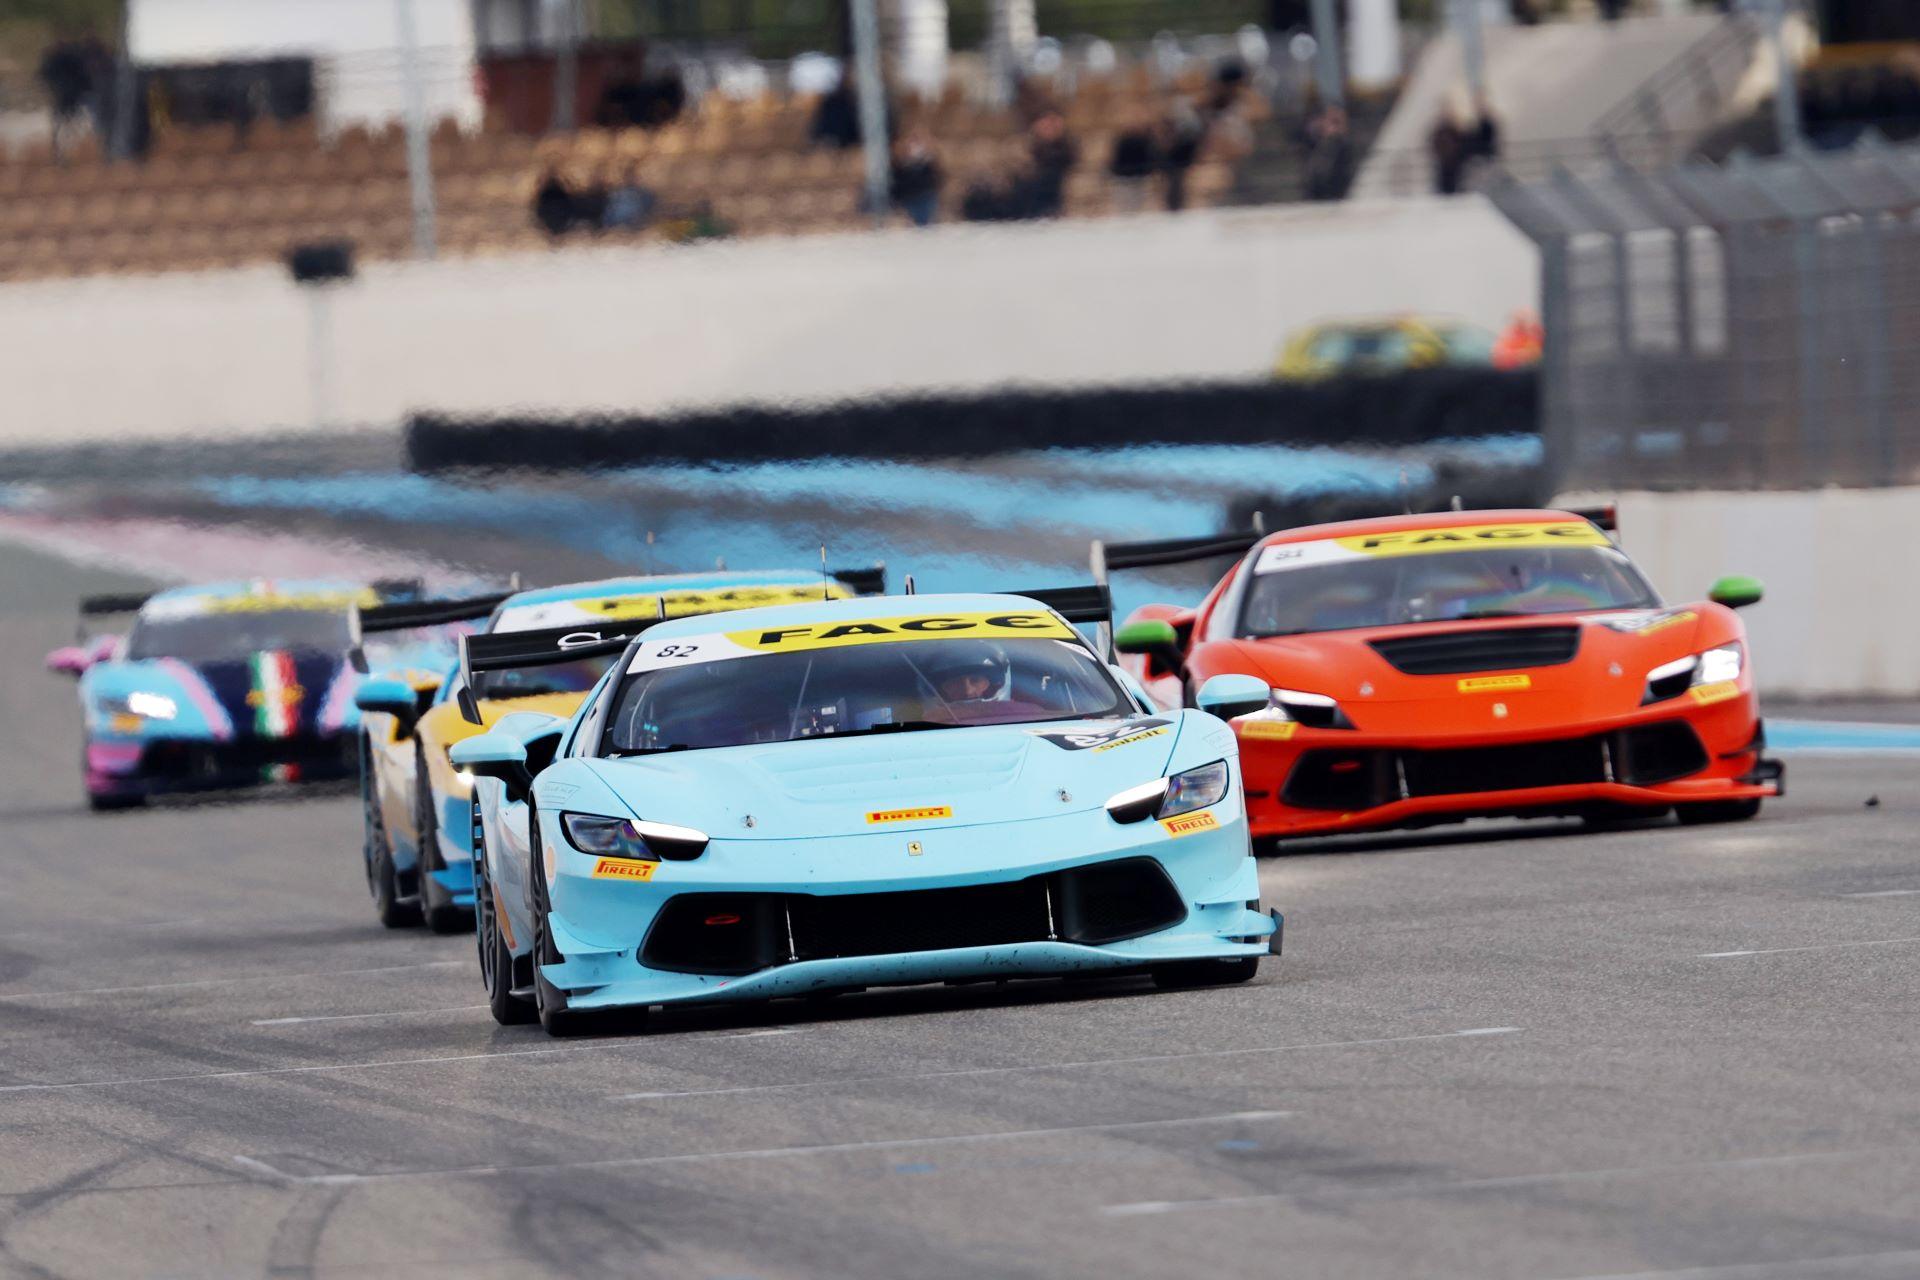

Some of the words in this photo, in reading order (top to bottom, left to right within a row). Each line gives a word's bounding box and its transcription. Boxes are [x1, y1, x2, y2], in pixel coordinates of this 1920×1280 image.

[758, 615, 1053, 645] FAGE
[656, 645, 699, 658] 82
[872, 806, 944, 821] PIRELLI
[1166, 812, 1215, 834] PIRELLI
[597, 860, 651, 877] PIRELLI
